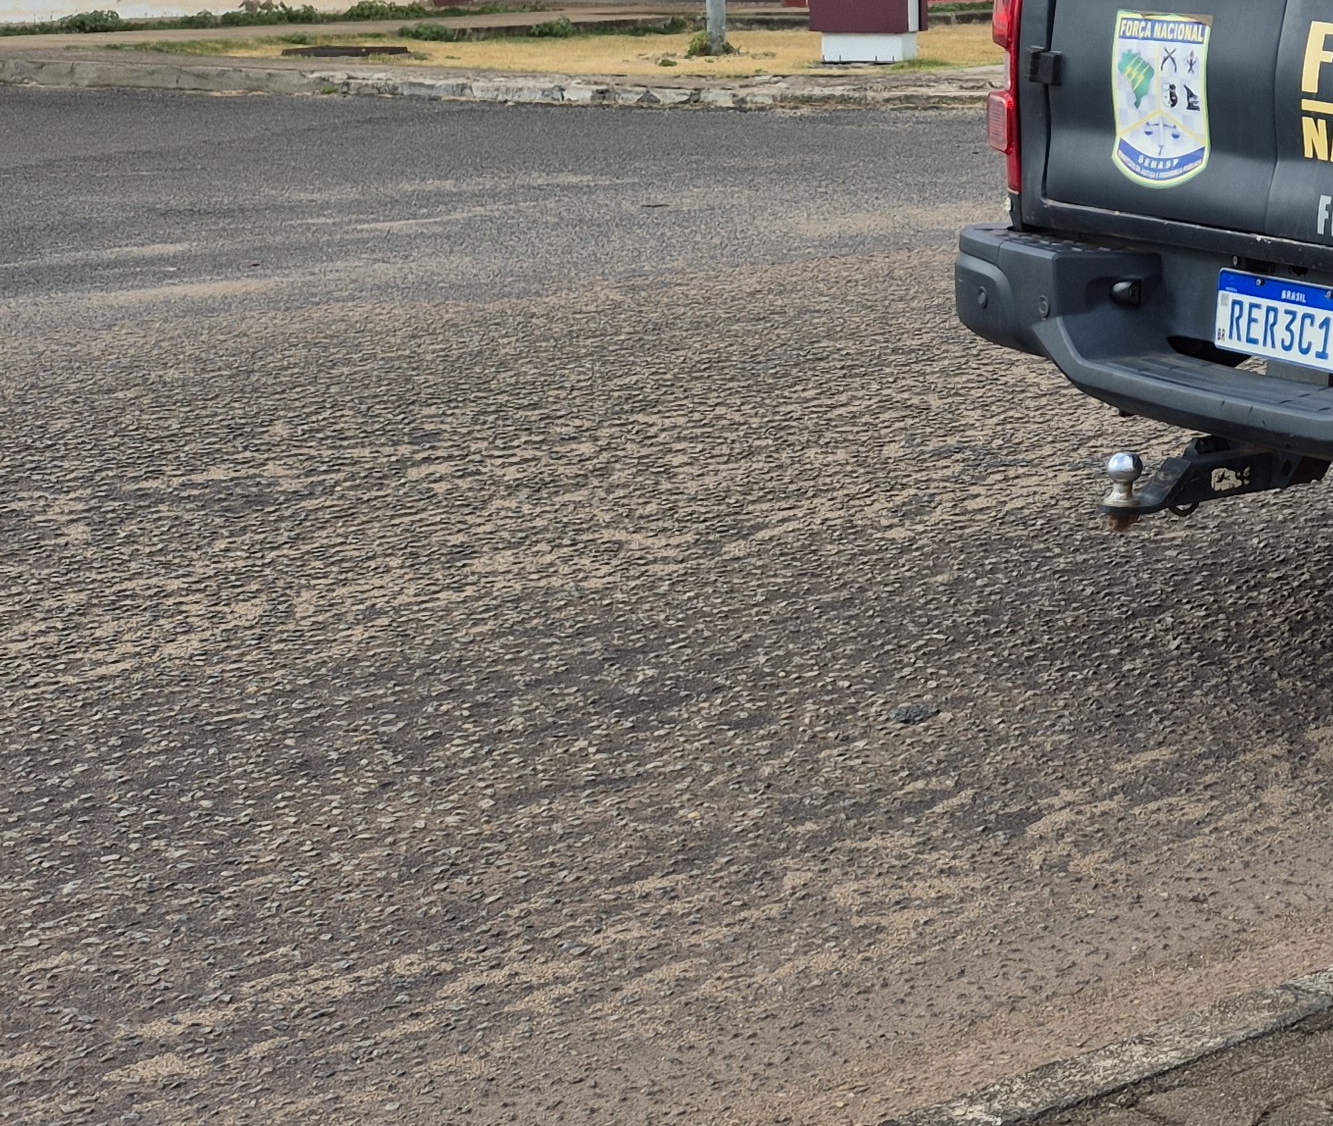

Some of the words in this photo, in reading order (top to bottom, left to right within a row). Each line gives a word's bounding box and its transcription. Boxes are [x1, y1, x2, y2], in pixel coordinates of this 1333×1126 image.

[1120, 19, 1152, 39] FORÇA
[1153, 22, 1204, 42] NACIONAL
[1281, 289, 1307, 303] BRASIL
